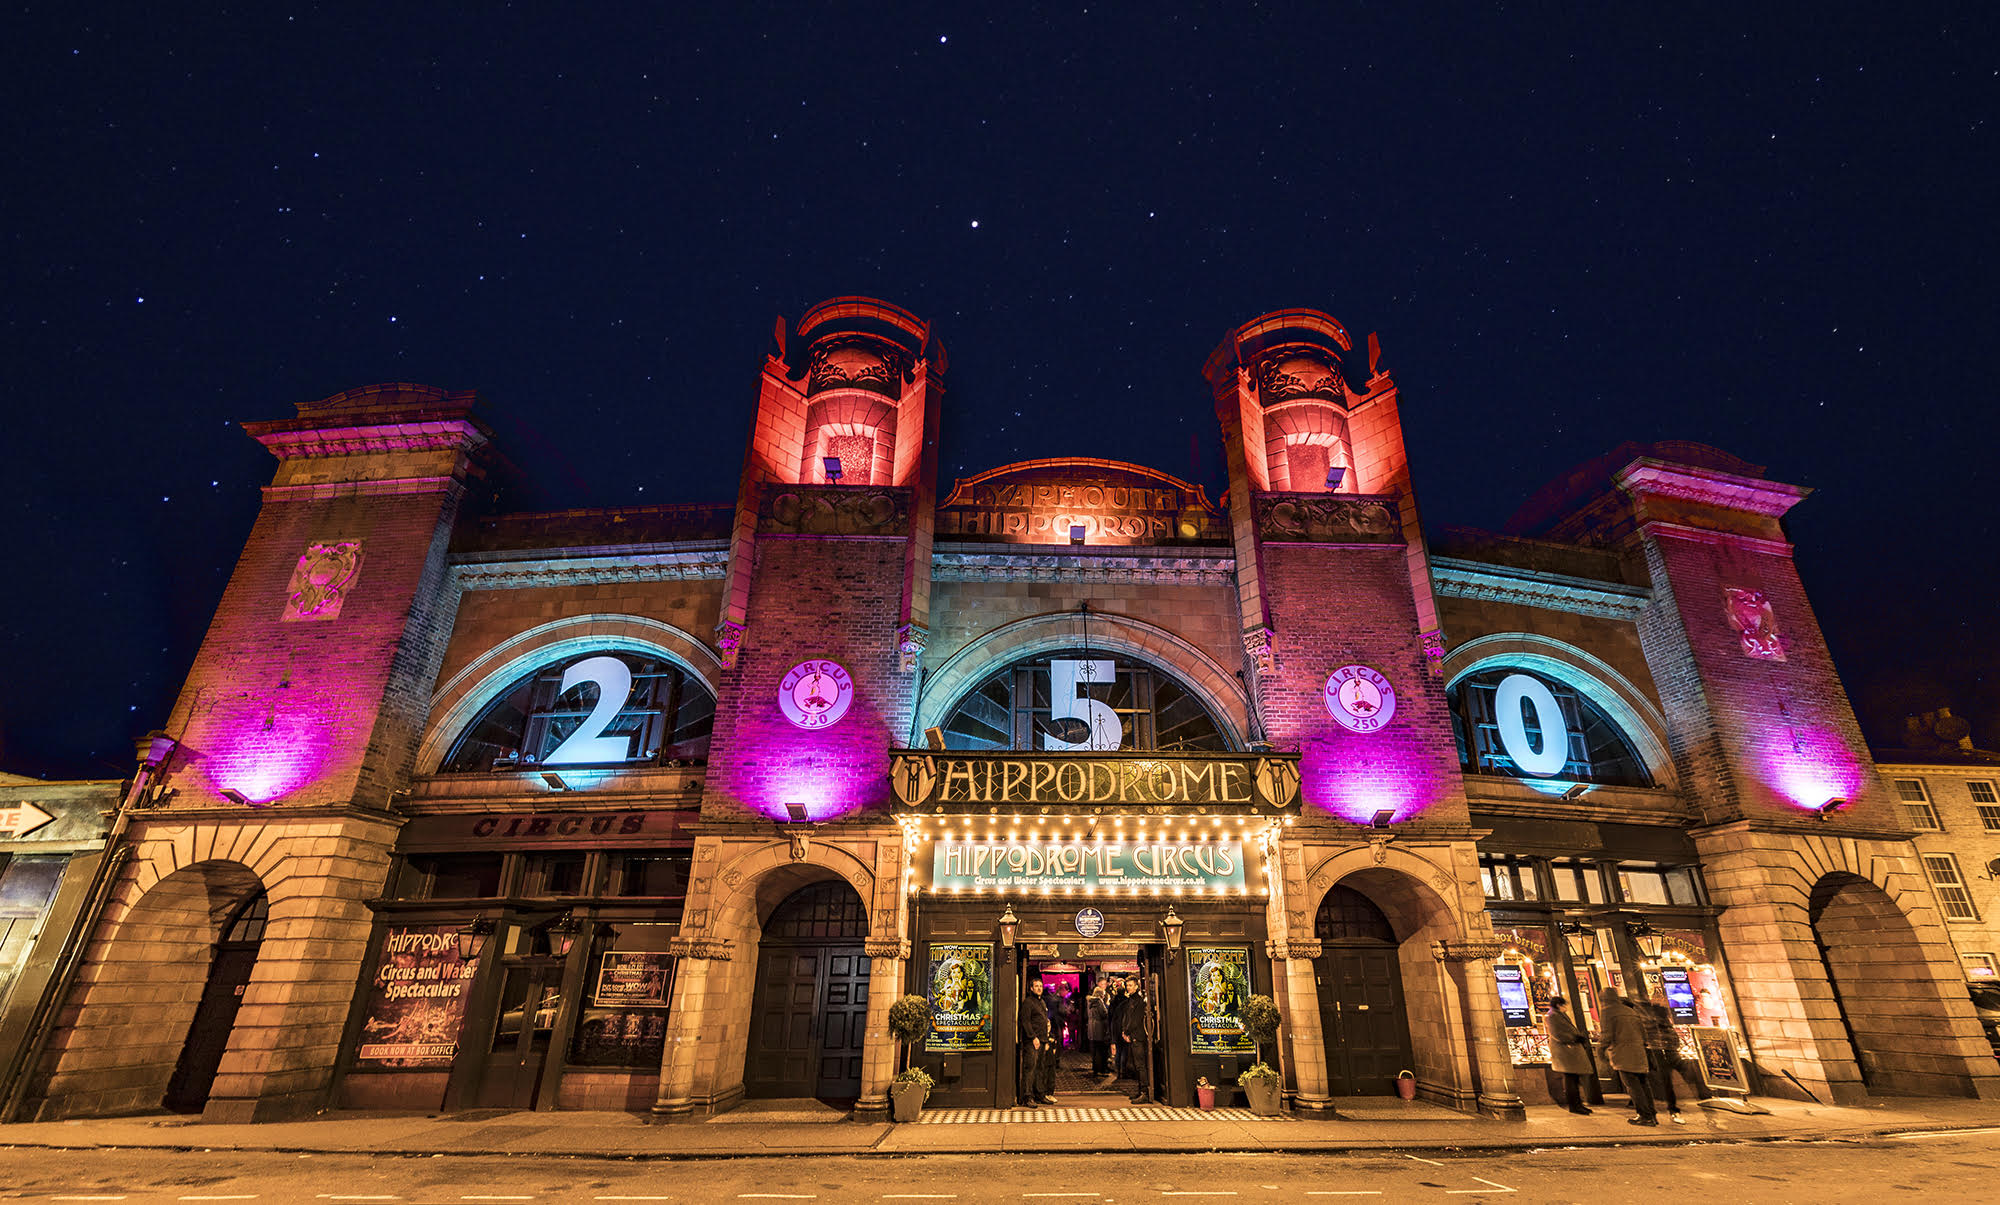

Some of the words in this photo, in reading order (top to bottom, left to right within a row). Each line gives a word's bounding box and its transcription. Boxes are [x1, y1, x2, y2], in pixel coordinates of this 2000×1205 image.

[984, 484, 1178, 509] YARMOUTH
[782, 662, 851, 692] CIRCUS
[1327, 667, 1392, 696] CIRCUS
[542, 656, 632, 765] 2
[1043, 659, 1122, 751] 5
[1495, 674, 1568, 777] 0
[1352, 718, 1379, 730] 250
[939, 760, 1252, 802] HIPPODROME
[472, 814, 646, 838] CIRCUS
[943, 844, 1125, 877] HIPPODROME
[1132, 845, 1236, 877] CIRCUS
[974, 876, 997, 886] Circus
[997, 876, 1012, 886] and
[1013, 876, 1038, 886] Water
[1039, 876, 1087, 887] Spectaculars
[1098, 876, 1206, 887] www.hippodromecircus.co.uk
[1514, 936, 1545, 954] OFFICE
[1677, 938, 1706, 956] OFFICE
[380, 964, 417, 981] Circus
[416, 962, 441, 980] and
[442, 962, 478, 980] Water
[385, 980, 461, 1002] Spectaculars
[935, 1013, 981, 1021] CHRISTMAS
[370, 1047, 388, 1056] BOOK
[390, 1047, 407, 1055] NOW
[407, 1047, 415, 1055] AT
[416, 1046, 430, 1055] BOX
[430, 1046, 454, 1055] OFFICE
